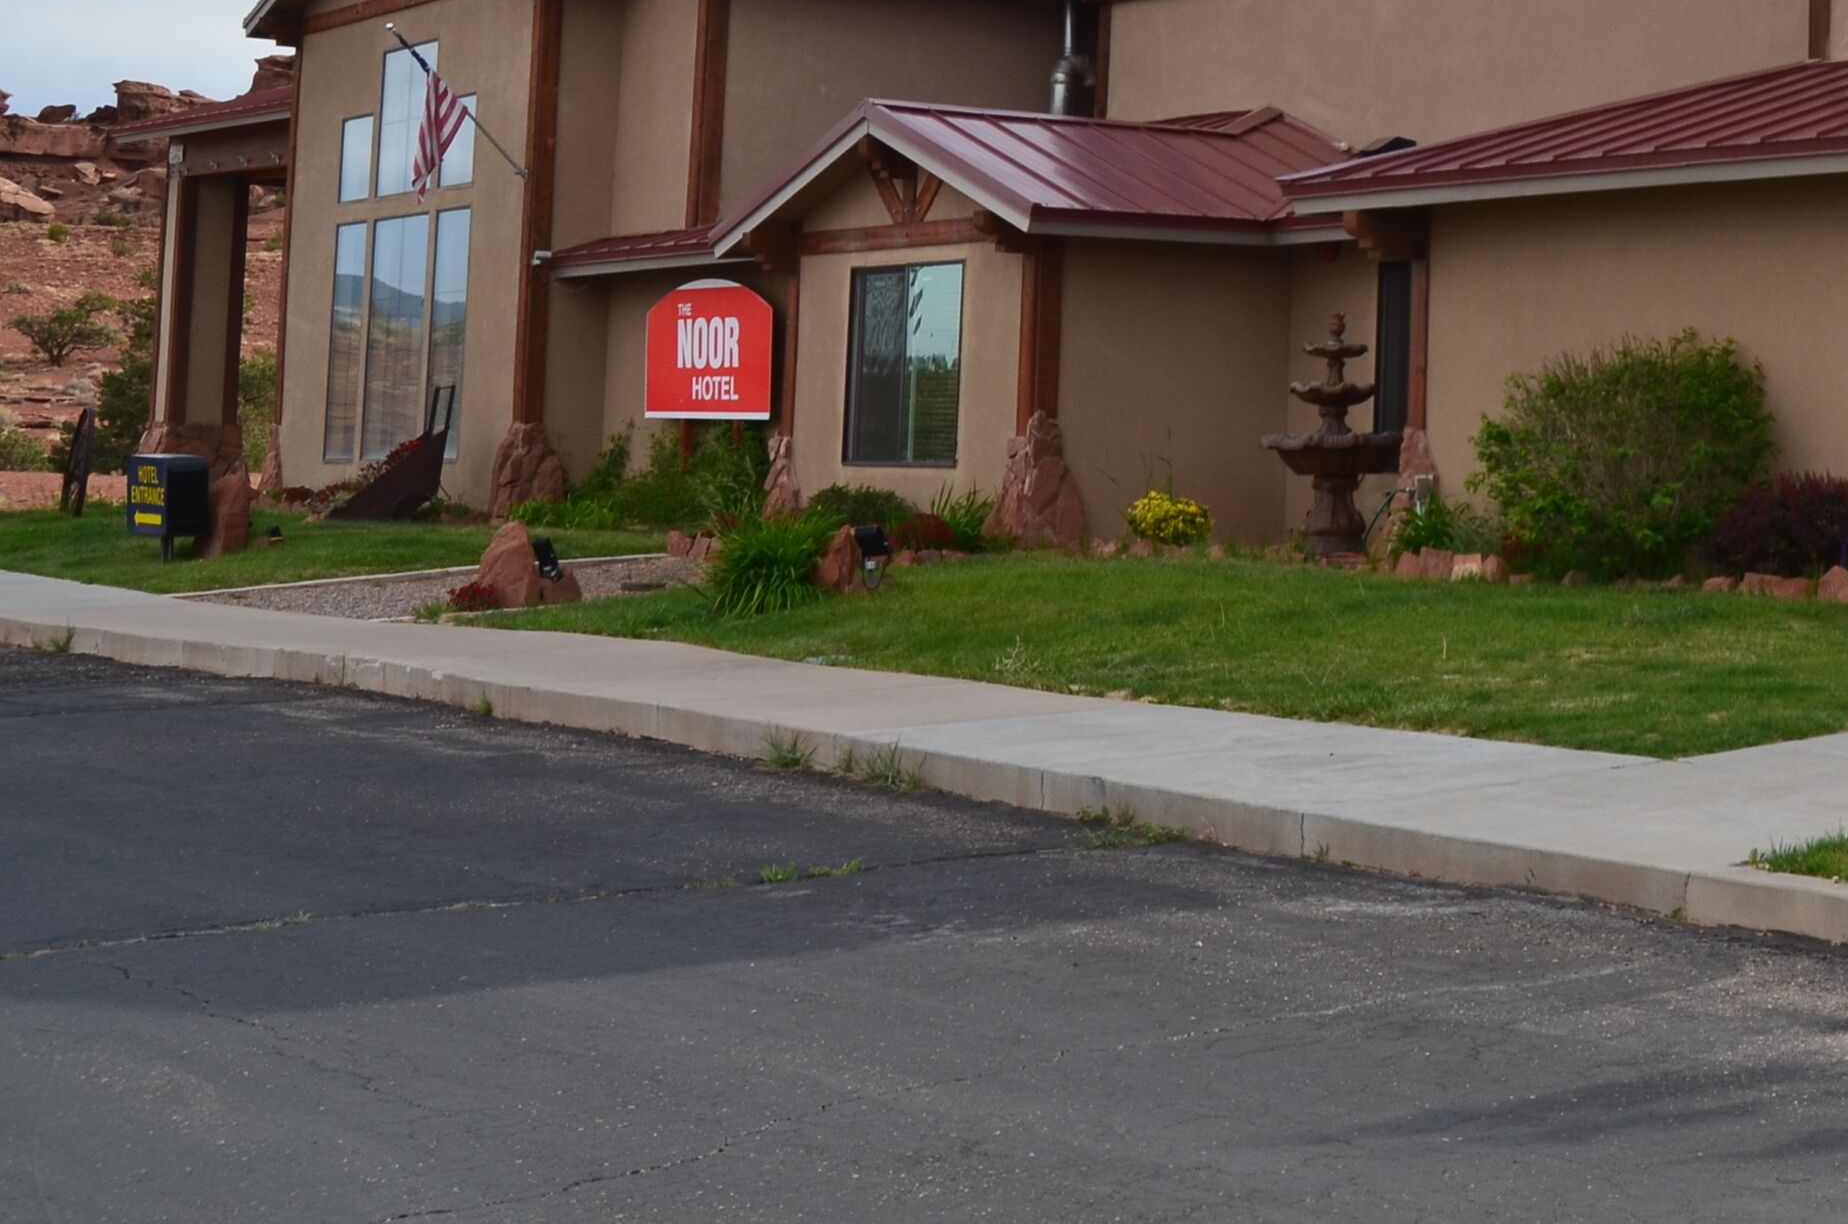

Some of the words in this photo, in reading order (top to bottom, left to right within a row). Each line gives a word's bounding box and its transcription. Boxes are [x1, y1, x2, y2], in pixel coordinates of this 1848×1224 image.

[678, 303, 692, 316] THE
[677, 316, 740, 369] NOOR
[692, 376, 739, 400] HOTEL
[138, 466, 159, 484] HOTEL
[131, 485, 165, 506] ENTRANCE
